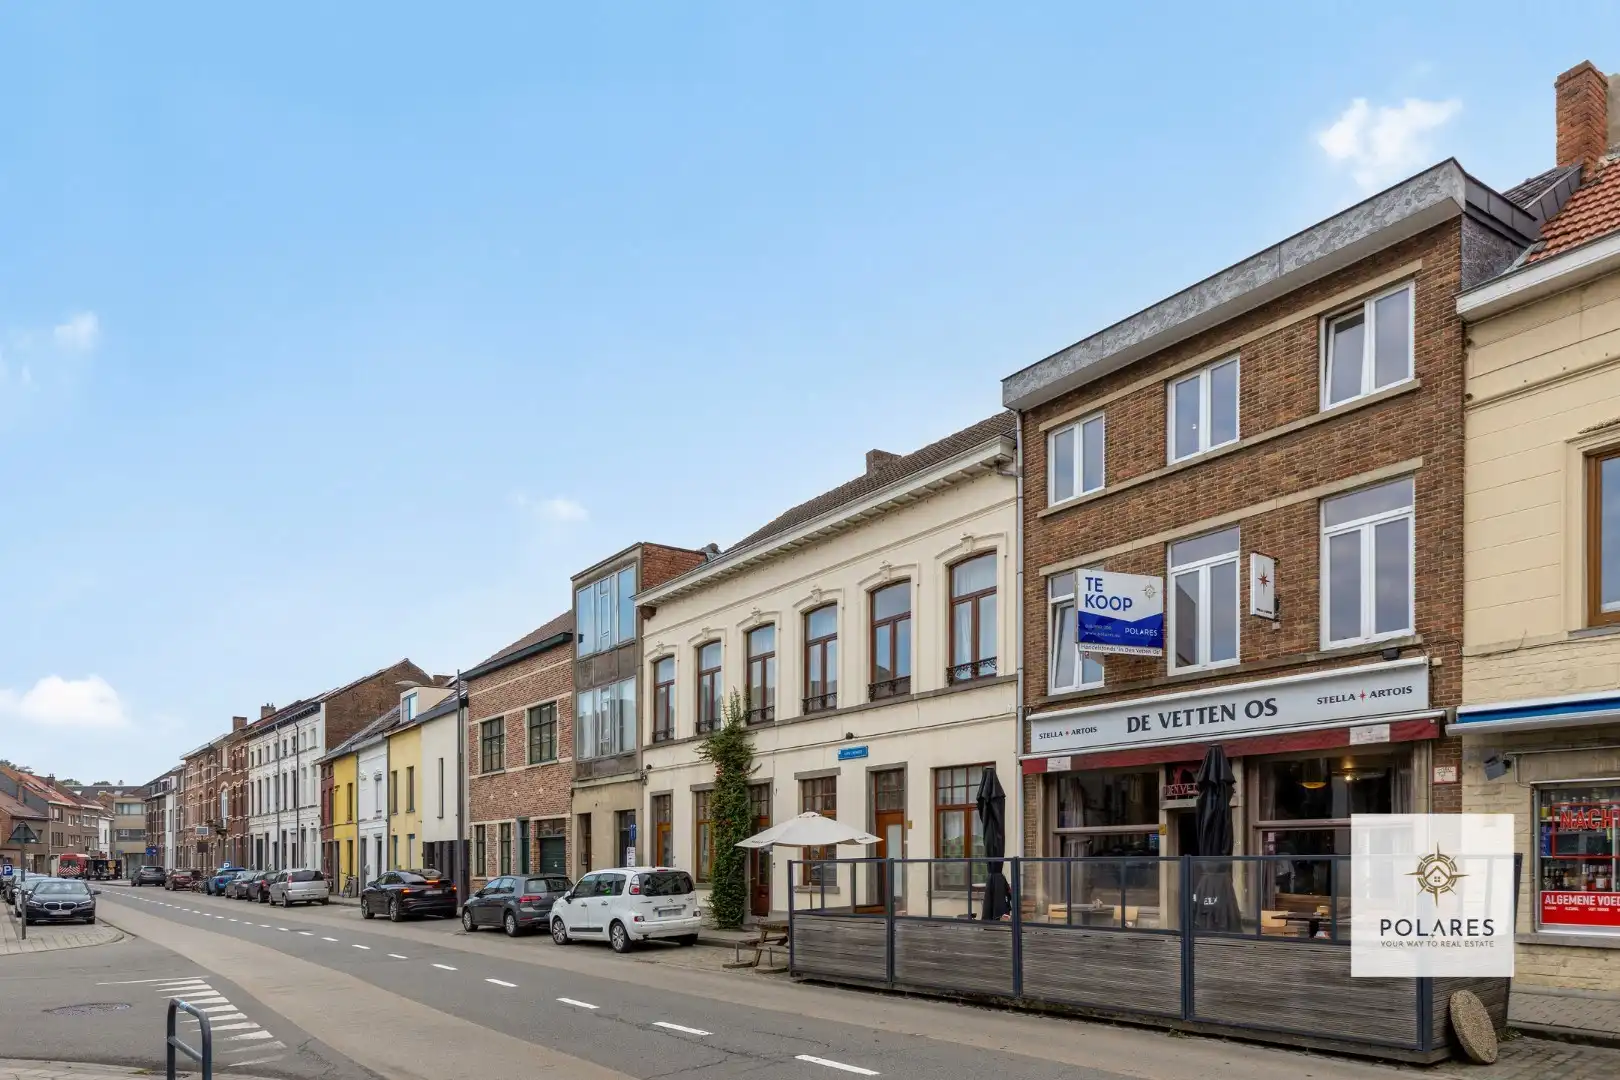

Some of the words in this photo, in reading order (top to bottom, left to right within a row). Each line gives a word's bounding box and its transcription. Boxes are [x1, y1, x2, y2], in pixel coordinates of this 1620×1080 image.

[1085, 577, 1103, 592] TE
[1085, 594, 1133, 611] KOOP
[1125, 628, 1158, 637] POLARES
[1317, 693, 1356, 705] STELLA
[1369, 685, 1413, 699] ARTOIS
[1127, 714, 1151, 734] DE
[1158, 703, 1236, 728] VETTEN
[1244, 697, 1278, 719] OS
[1039, 730, 1063, 739] STELLA
[1071, 726, 1097, 736] ARTOIS
[4, 866, 11, 874] P
[1544, 894, 1596, 905] ALGEMENE
